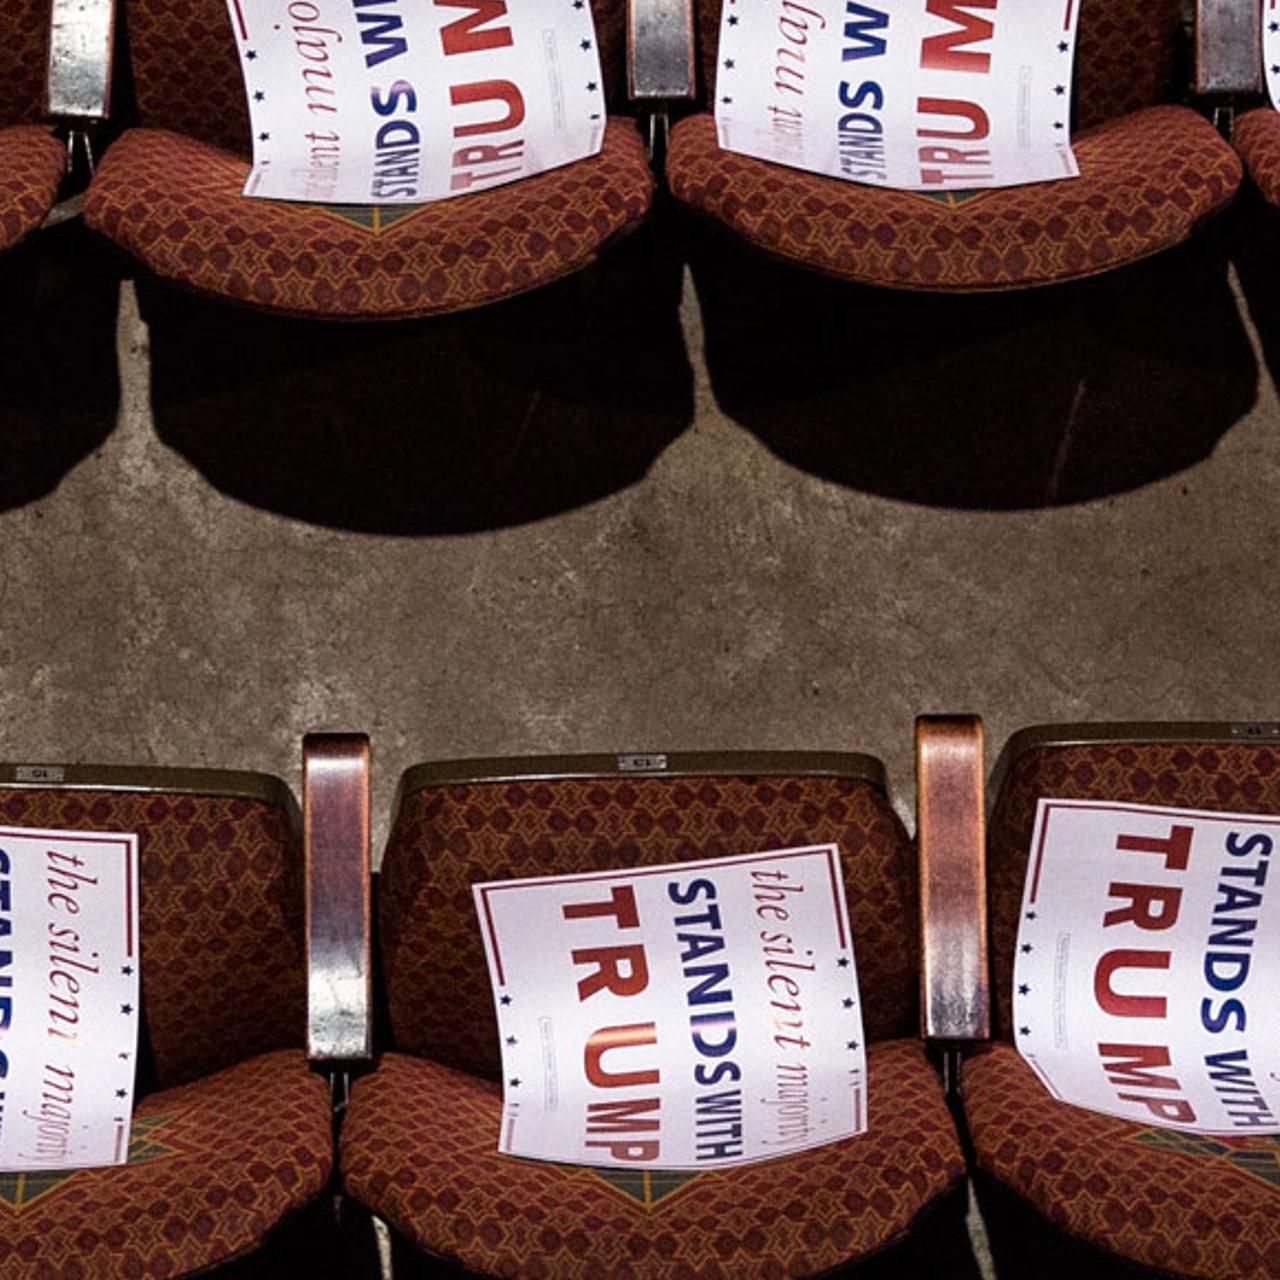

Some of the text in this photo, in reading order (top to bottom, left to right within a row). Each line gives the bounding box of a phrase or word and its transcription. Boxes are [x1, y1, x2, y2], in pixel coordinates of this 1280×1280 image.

[371, 80, 420, 198] STANDS
[838, 80, 887, 179] STANDS
[46, 850, 98, 915] the
[750, 869, 804, 922] the
[562, 884, 660, 1162] TRUMP
[668, 877, 743, 1161] STANDS WITH
[761, 930, 815, 1050] silent
[1093, 824, 1197, 1124] TRUMP
[1200, 831, 1280, 1127] STANDS WITH
